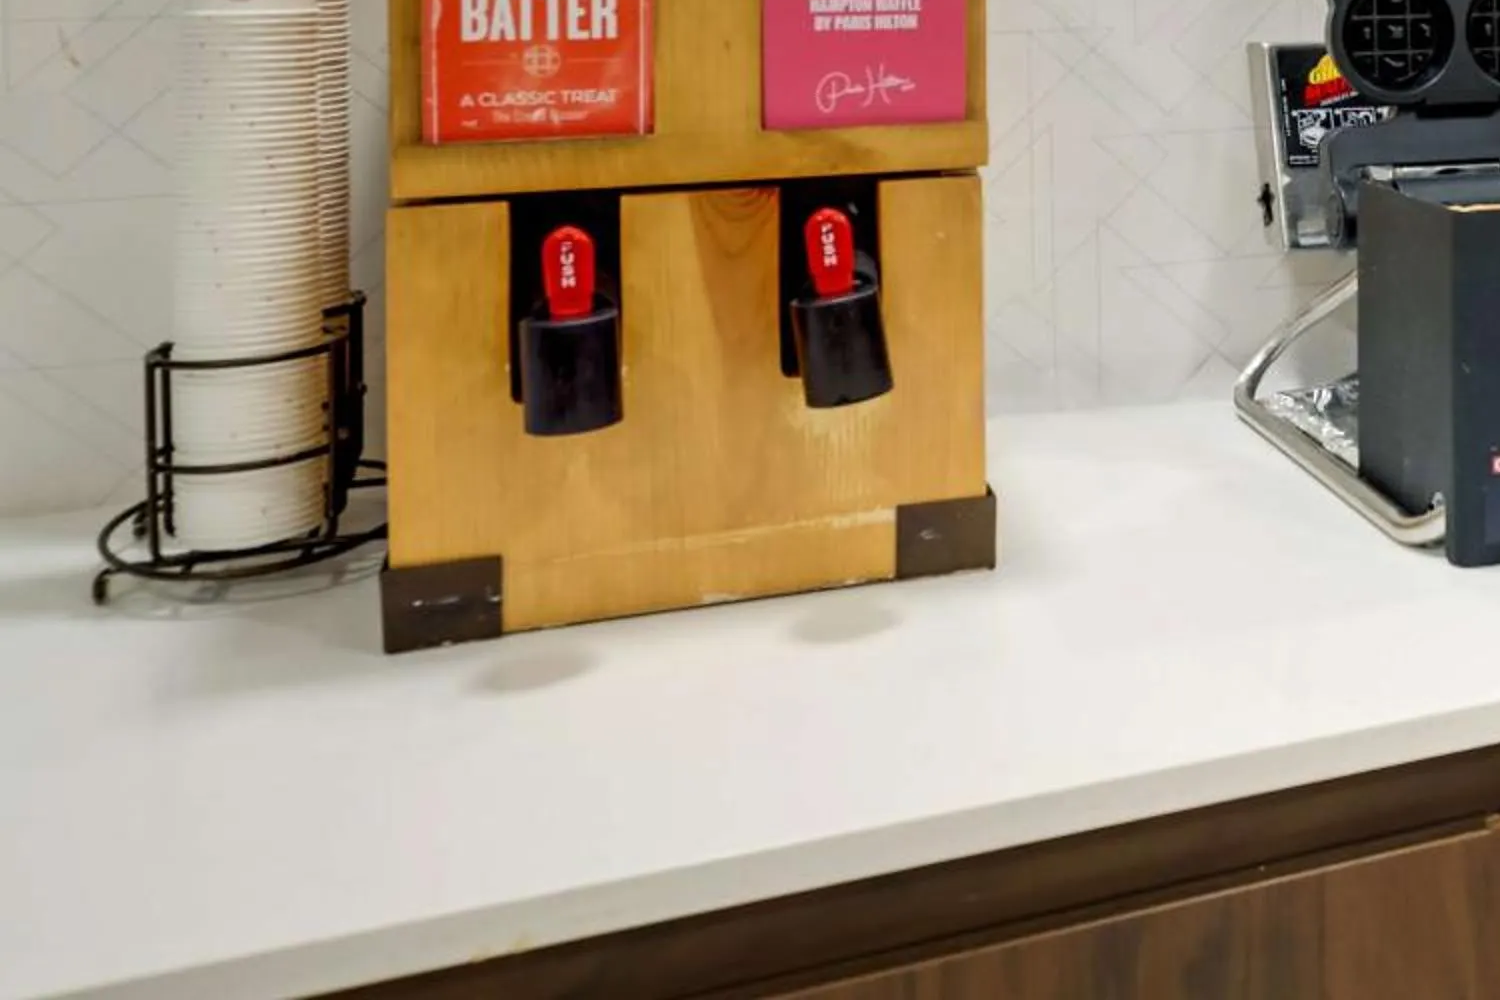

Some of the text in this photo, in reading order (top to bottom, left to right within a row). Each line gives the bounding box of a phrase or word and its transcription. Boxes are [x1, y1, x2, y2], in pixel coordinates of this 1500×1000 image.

[459, 88, 618, 108] A CLASSIC TREAT
